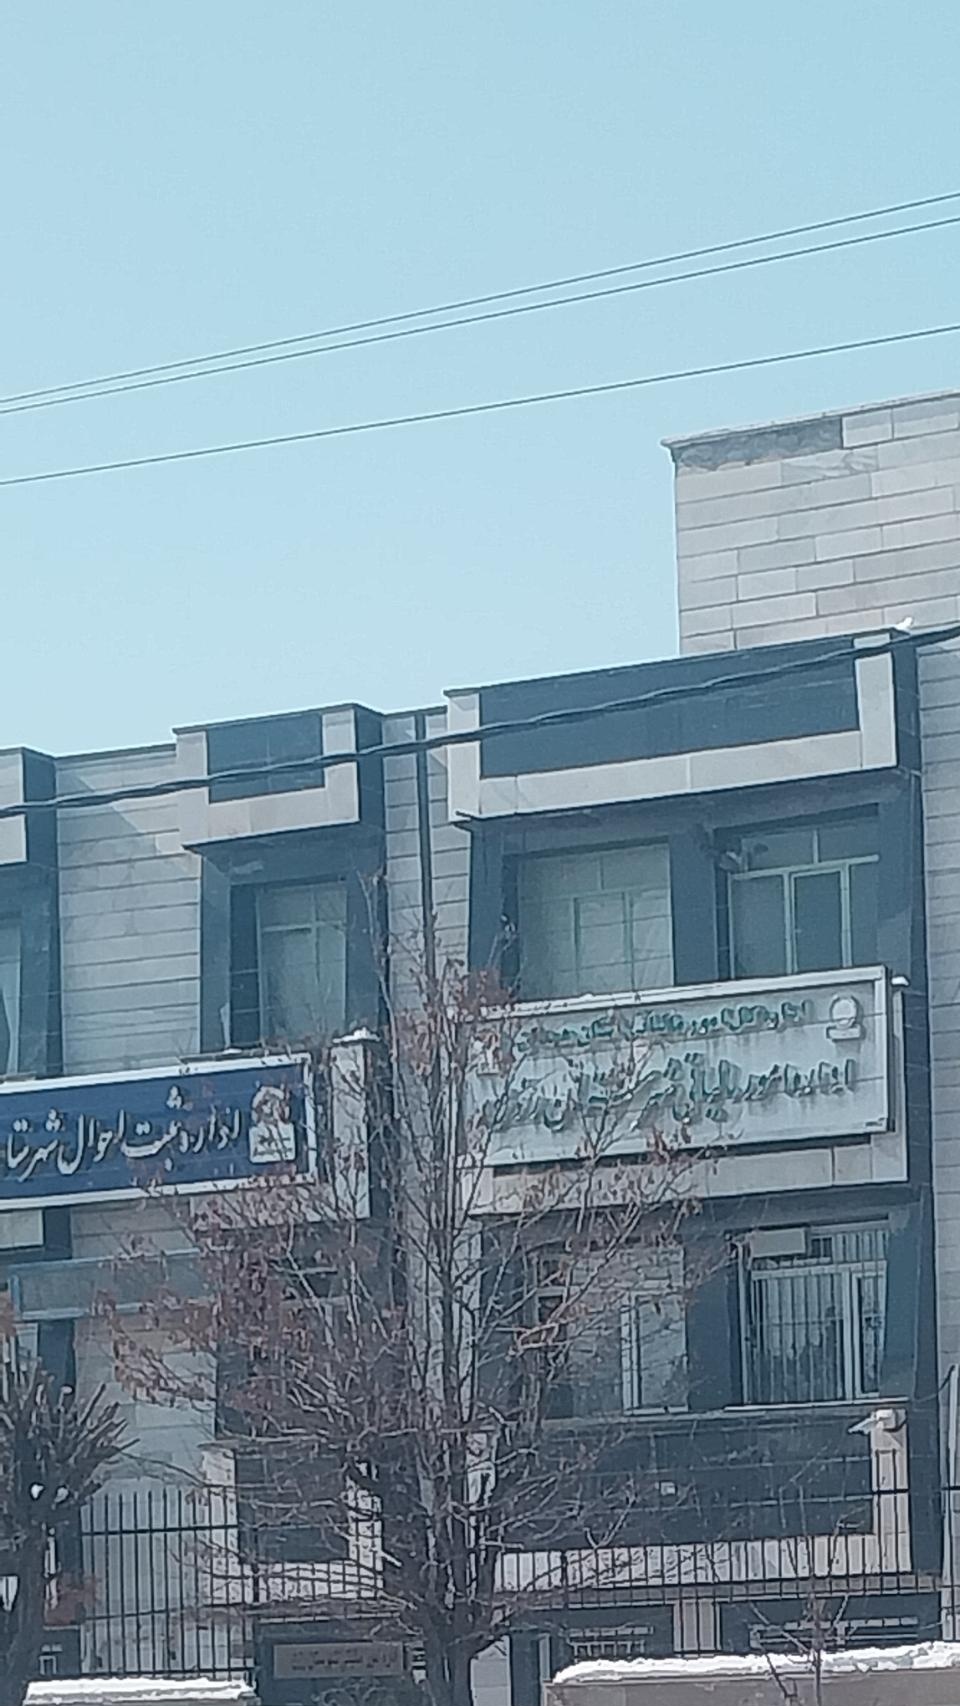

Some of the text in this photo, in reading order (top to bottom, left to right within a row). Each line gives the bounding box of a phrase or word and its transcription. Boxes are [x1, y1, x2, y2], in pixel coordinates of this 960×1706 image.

[6, 1107, 64, 1183] شهرستا
[56, 1109, 125, 1176] احوال
[122, 1084, 184, 1173] ثبت
[178, 1104, 241, 1154] اداره
